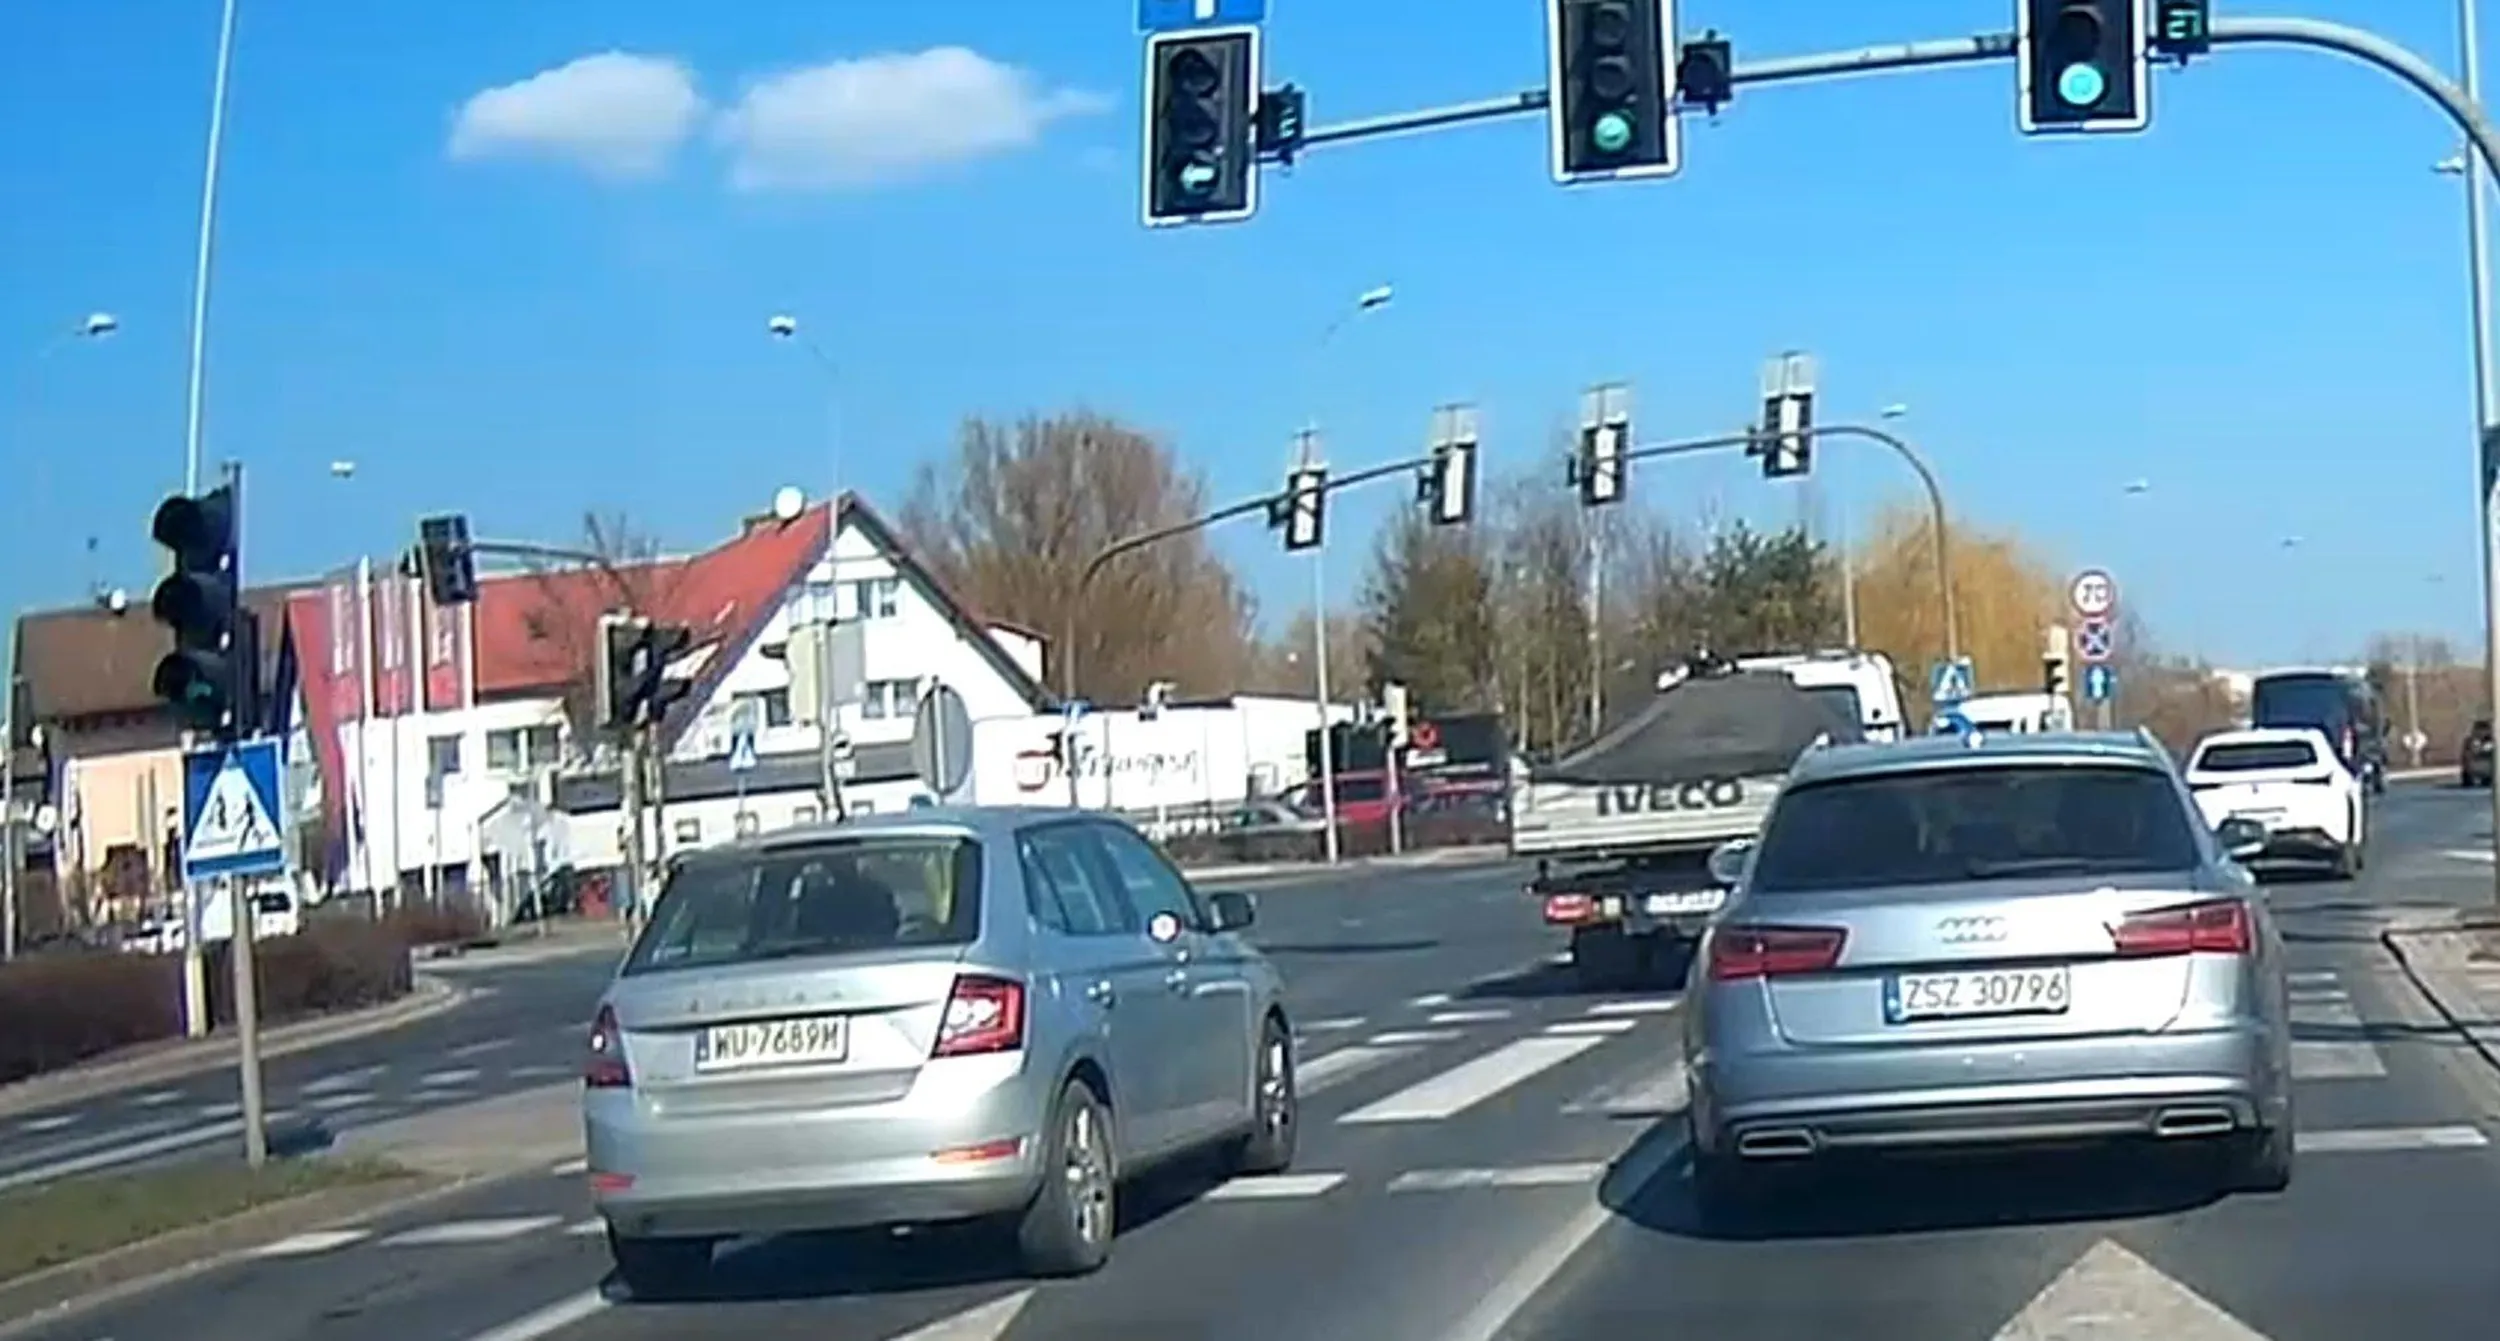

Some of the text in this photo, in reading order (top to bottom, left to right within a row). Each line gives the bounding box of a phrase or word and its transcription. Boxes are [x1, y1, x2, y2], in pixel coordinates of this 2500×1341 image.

[1597, 779, 1743, 816] IVECO
[1905, 972, 2064, 1009] ZSZ 30796
